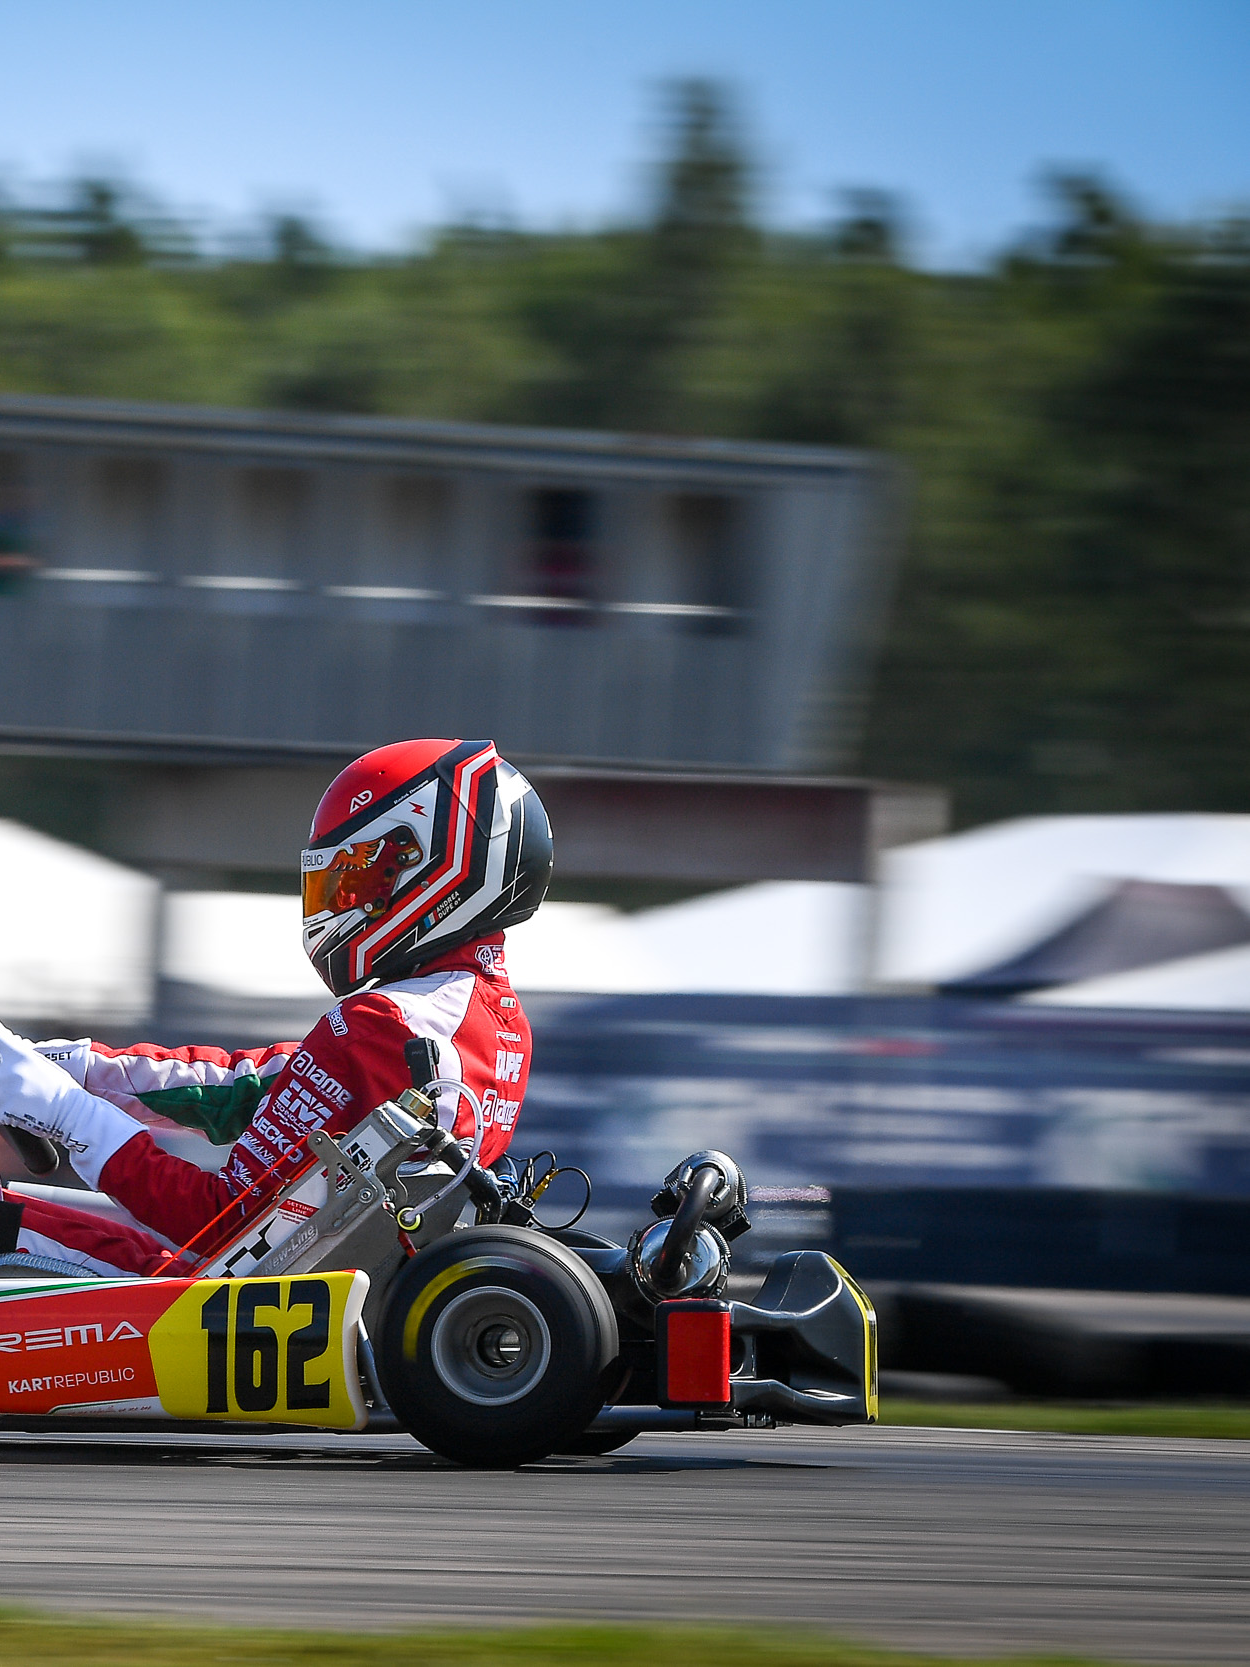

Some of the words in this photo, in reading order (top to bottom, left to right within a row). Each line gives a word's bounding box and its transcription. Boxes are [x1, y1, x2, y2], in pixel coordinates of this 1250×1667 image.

[436, 891, 460, 912] ANDREA
[438, 903, 454, 919] DUPE
[495, 1050, 524, 1083] DUPE
[275, 1100, 312, 1134] TECHNOLOG
[201, 1280, 330, 1413] 162
[8, 1367, 135, 1394] KARTREPUBLIC
